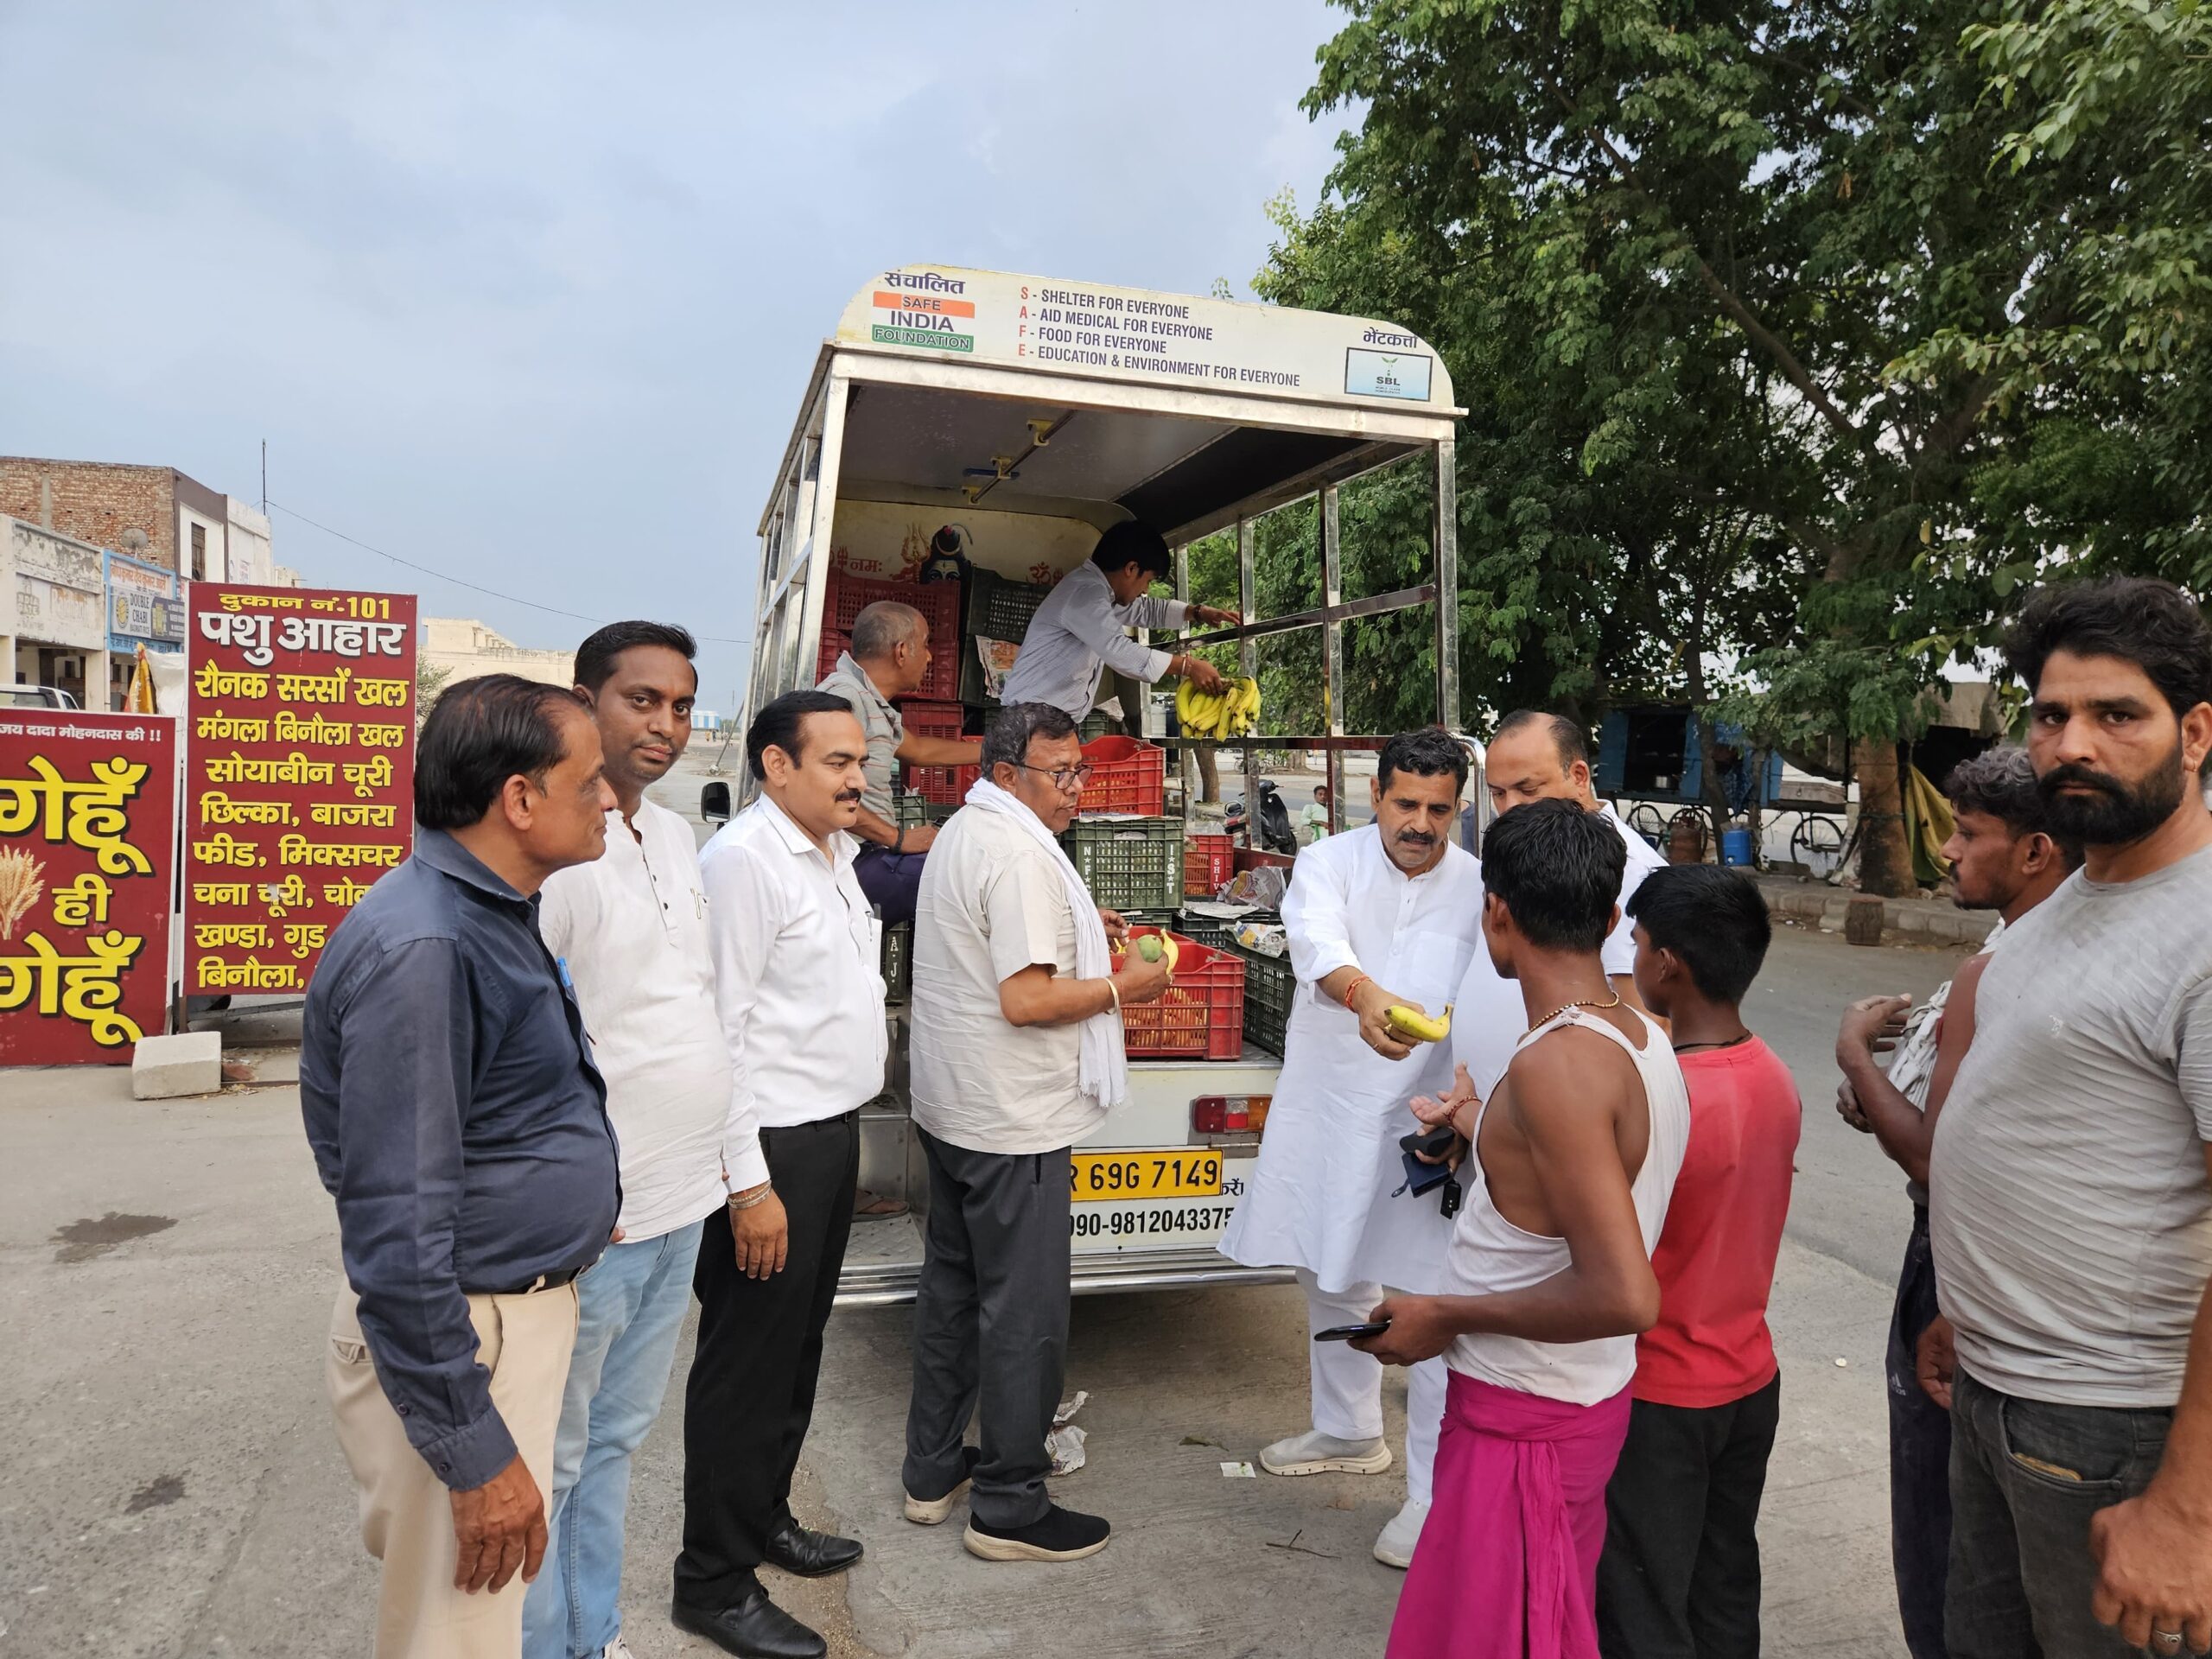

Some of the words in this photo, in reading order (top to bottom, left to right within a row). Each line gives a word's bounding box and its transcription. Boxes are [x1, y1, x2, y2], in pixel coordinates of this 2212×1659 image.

[885, 269, 966, 295] संचालित
[902, 296, 941, 311] SAFE
[1020, 287, 1028, 300] S
[1041, 289, 1095, 308] SHELTER
[1099, 296, 1123, 311] FOR
[1127, 300, 1189, 319] EVERYONE
[891, 310, 954, 332] INDIA
[1020, 306, 1028, 319] A
[1040, 308, 1061, 322] AID
[1065, 311, 1120, 329] MEDICAL
[1124, 318, 1147, 333] FOR
[1152, 321, 1213, 340] EVERYONE
[874, 328, 969, 349] FOUNDATION
[1020, 325, 1027, 337] F
[1039, 327, 1072, 343] FOOD
[1077, 332, 1101, 346] FOR
[1104, 334, 1166, 353] EVERYONE
[1019, 344, 1026, 356] E
[1039, 346, 1107, 365] EDUCATION
[1112, 354, 1120, 367] &
[1124, 355, 1210, 377] ENVIRONMENT
[1214, 365, 1236, 380] FOR
[1241, 369, 1300, 386] EVERYONE
[1376, 377, 1401, 385] SBL
[130, 593, 149, 609] DOUBLE
[219, 594, 304, 611] दुकान
[198, 611, 275, 666] पशु
[276, 617, 407, 656] आहार
[194, 658, 270, 699] रौनक
[276, 666, 352, 703] सरसों
[354, 677, 410, 706] खल
[0, 724, 23, 735] जय
[27, 725, 55, 737] दादा
[59, 723, 123, 741] मोहनदास
[125, 727, 145, 741] की
[197, 709, 270, 743] मंगला
[275, 710, 353, 746] बिनौला
[358, 723, 406, 747] खल
[205, 751, 336, 785] सोयाबीन
[342, 754, 394, 798] चूरी
[0, 754, 153, 874] गेहूँ
[200, 791, 300, 827] छिल्का,
[310, 803, 397, 827] बाजरा
[193, 832, 267, 868] फीड,
[278, 834, 404, 868] मिक्सचर
[52, 873, 113, 925] ही
[193, 883, 251, 906] चना
[197, 955, 304, 988] बिनौला,
[0, 930, 144, 1046] गेहूँ
[1090, 1162, 1140, 1191] 69G
[1152, 1160, 1217, 1189] 7149
